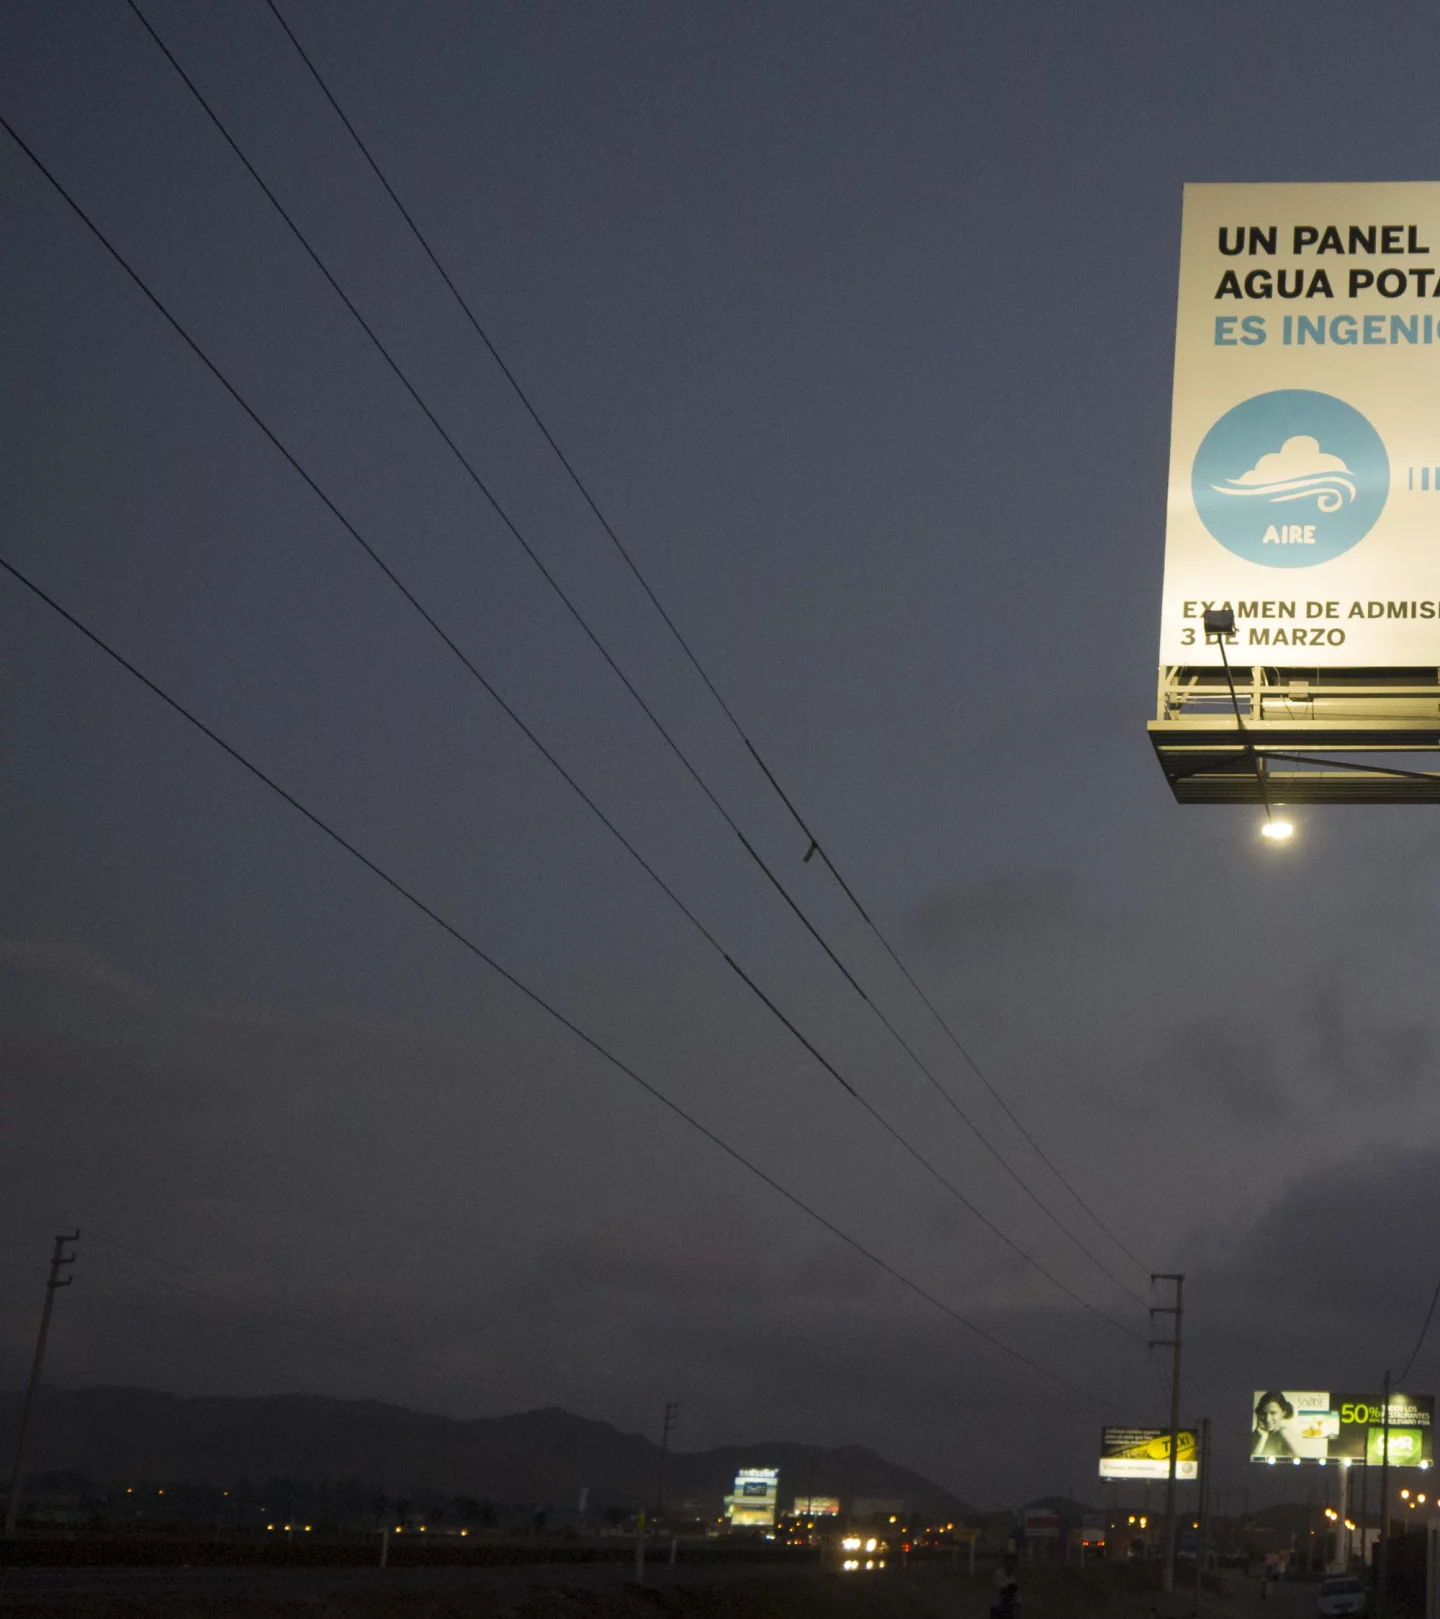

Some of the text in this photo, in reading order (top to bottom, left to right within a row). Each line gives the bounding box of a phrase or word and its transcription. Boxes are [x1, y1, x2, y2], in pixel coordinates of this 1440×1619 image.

[1218, 226, 1278, 256] UN
[1292, 224, 1430, 255] PANEL
[1214, 268, 1334, 299] AGUA
[1213, 315, 1267, 346] ES
[1262, 524, 1317, 544] AIRE
[1306, 601, 1340, 619] DE
[1181, 629, 1196, 646] 3
[1249, 628, 1345, 646] MARZO
[1341, 1404, 1380, 1423] 50%
